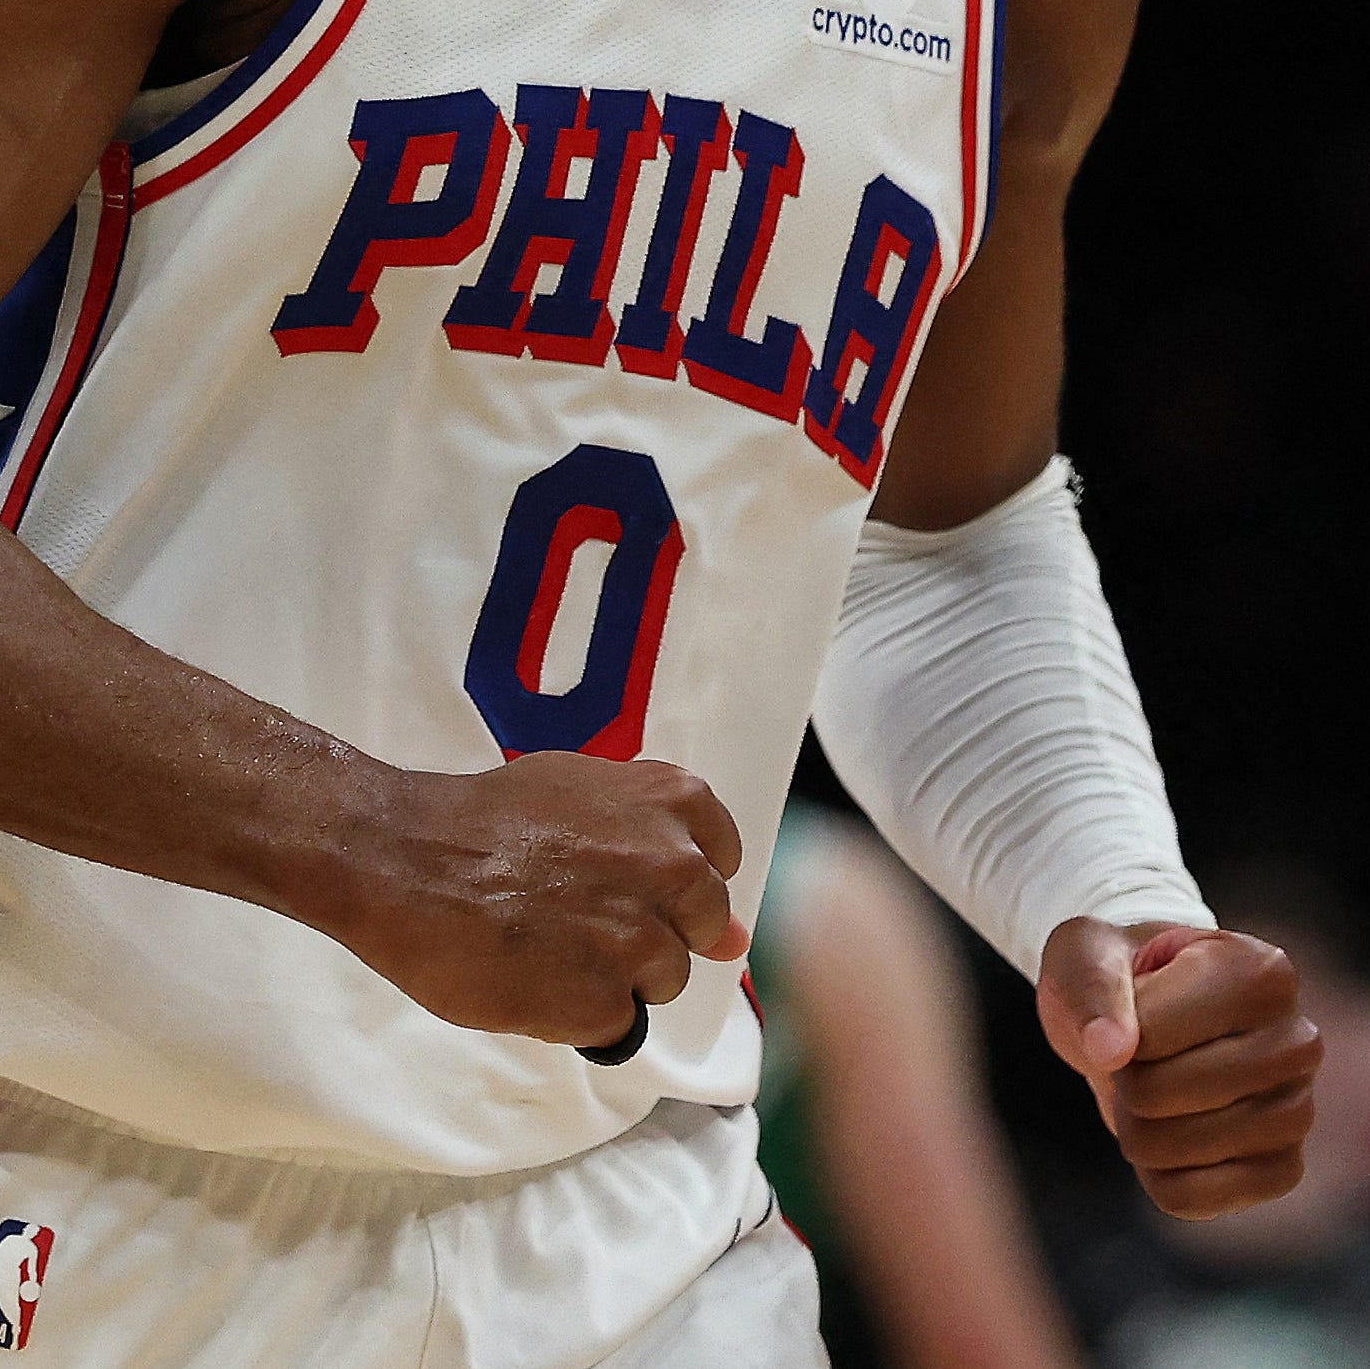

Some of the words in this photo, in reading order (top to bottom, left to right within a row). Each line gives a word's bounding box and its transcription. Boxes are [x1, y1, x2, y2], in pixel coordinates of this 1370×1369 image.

[812, 7, 951, 62] crypto.com
[270, 83, 943, 492] PHILA
[463, 442, 687, 762] 0
